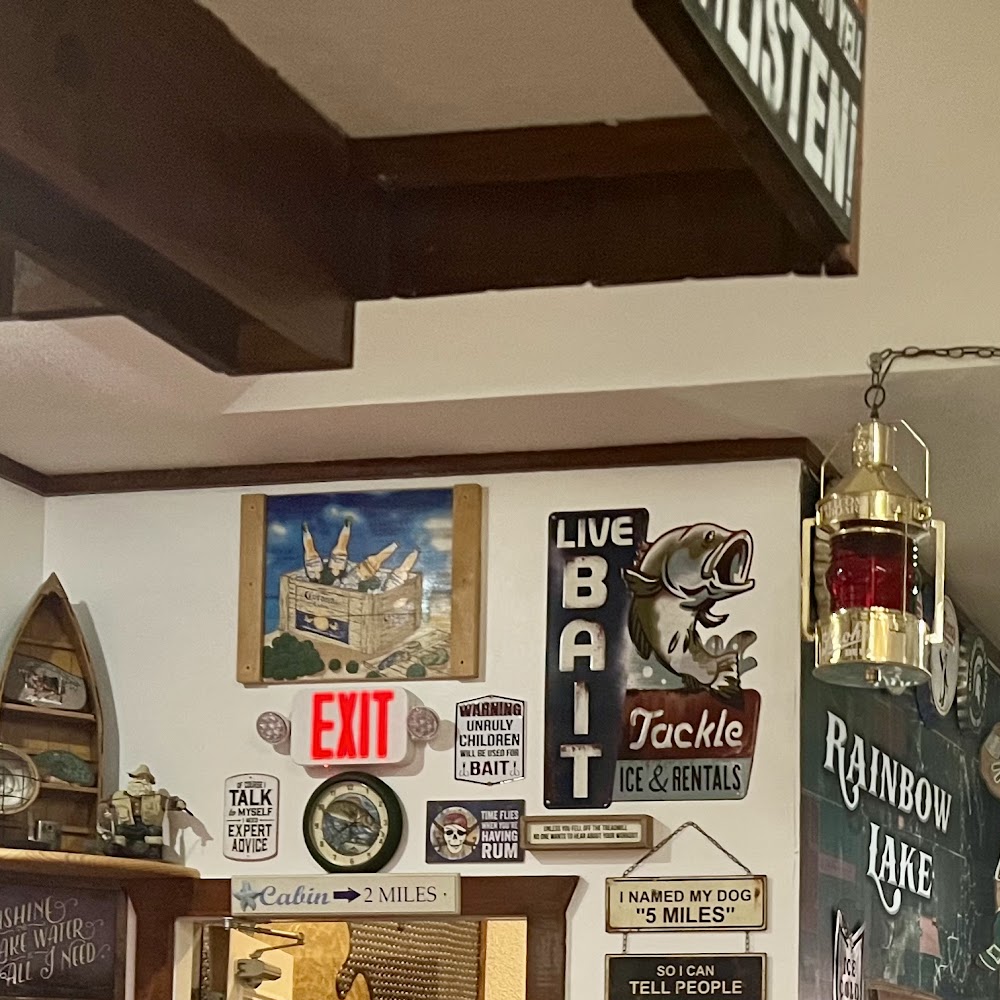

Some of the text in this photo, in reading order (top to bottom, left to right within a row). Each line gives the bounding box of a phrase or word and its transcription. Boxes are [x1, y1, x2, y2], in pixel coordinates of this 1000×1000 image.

[556, 516, 634, 548] LIVE
[559, 555, 608, 799] BAIT
[459, 702, 521, 717] WARNING
[310, 690, 394, 760] EXIT
[467, 719, 513, 731] UNRULY
[629, 706, 744, 750] Tackle
[459, 734, 520, 746] CHILDREN
[460, 748, 519, 757] WILL BE USED FOR
[470, 761, 510, 775] BAIT
[823, 711, 952, 834] RAINBOW
[620, 764, 741, 793] ICE & RENTALS
[229, 789, 272, 806] TALK
[238, 808, 273, 816] MYSELF
[481, 810, 519, 820] TIME FLIES
[228, 824, 272, 837] EXPERT
[481, 830, 519, 842] HAVING
[232, 838, 268, 853] ADVICE
[481, 842, 518, 859] RUM
[867, 822, 934, 915] LAKE
[254, 885, 437, 906] Cabin 2 MILES
[619, 889, 751, 903] I NAMED MY DOG
[636, 906, 735, 923] "5 MILES"
[33, 918, 93, 949] WATER
[656, 964, 715, 977] SO I CAN
[843, 957, 857, 977] ICE
[629, 980, 743, 995] TELL PEOPLE
[840, 980, 859, 1000] COLD
